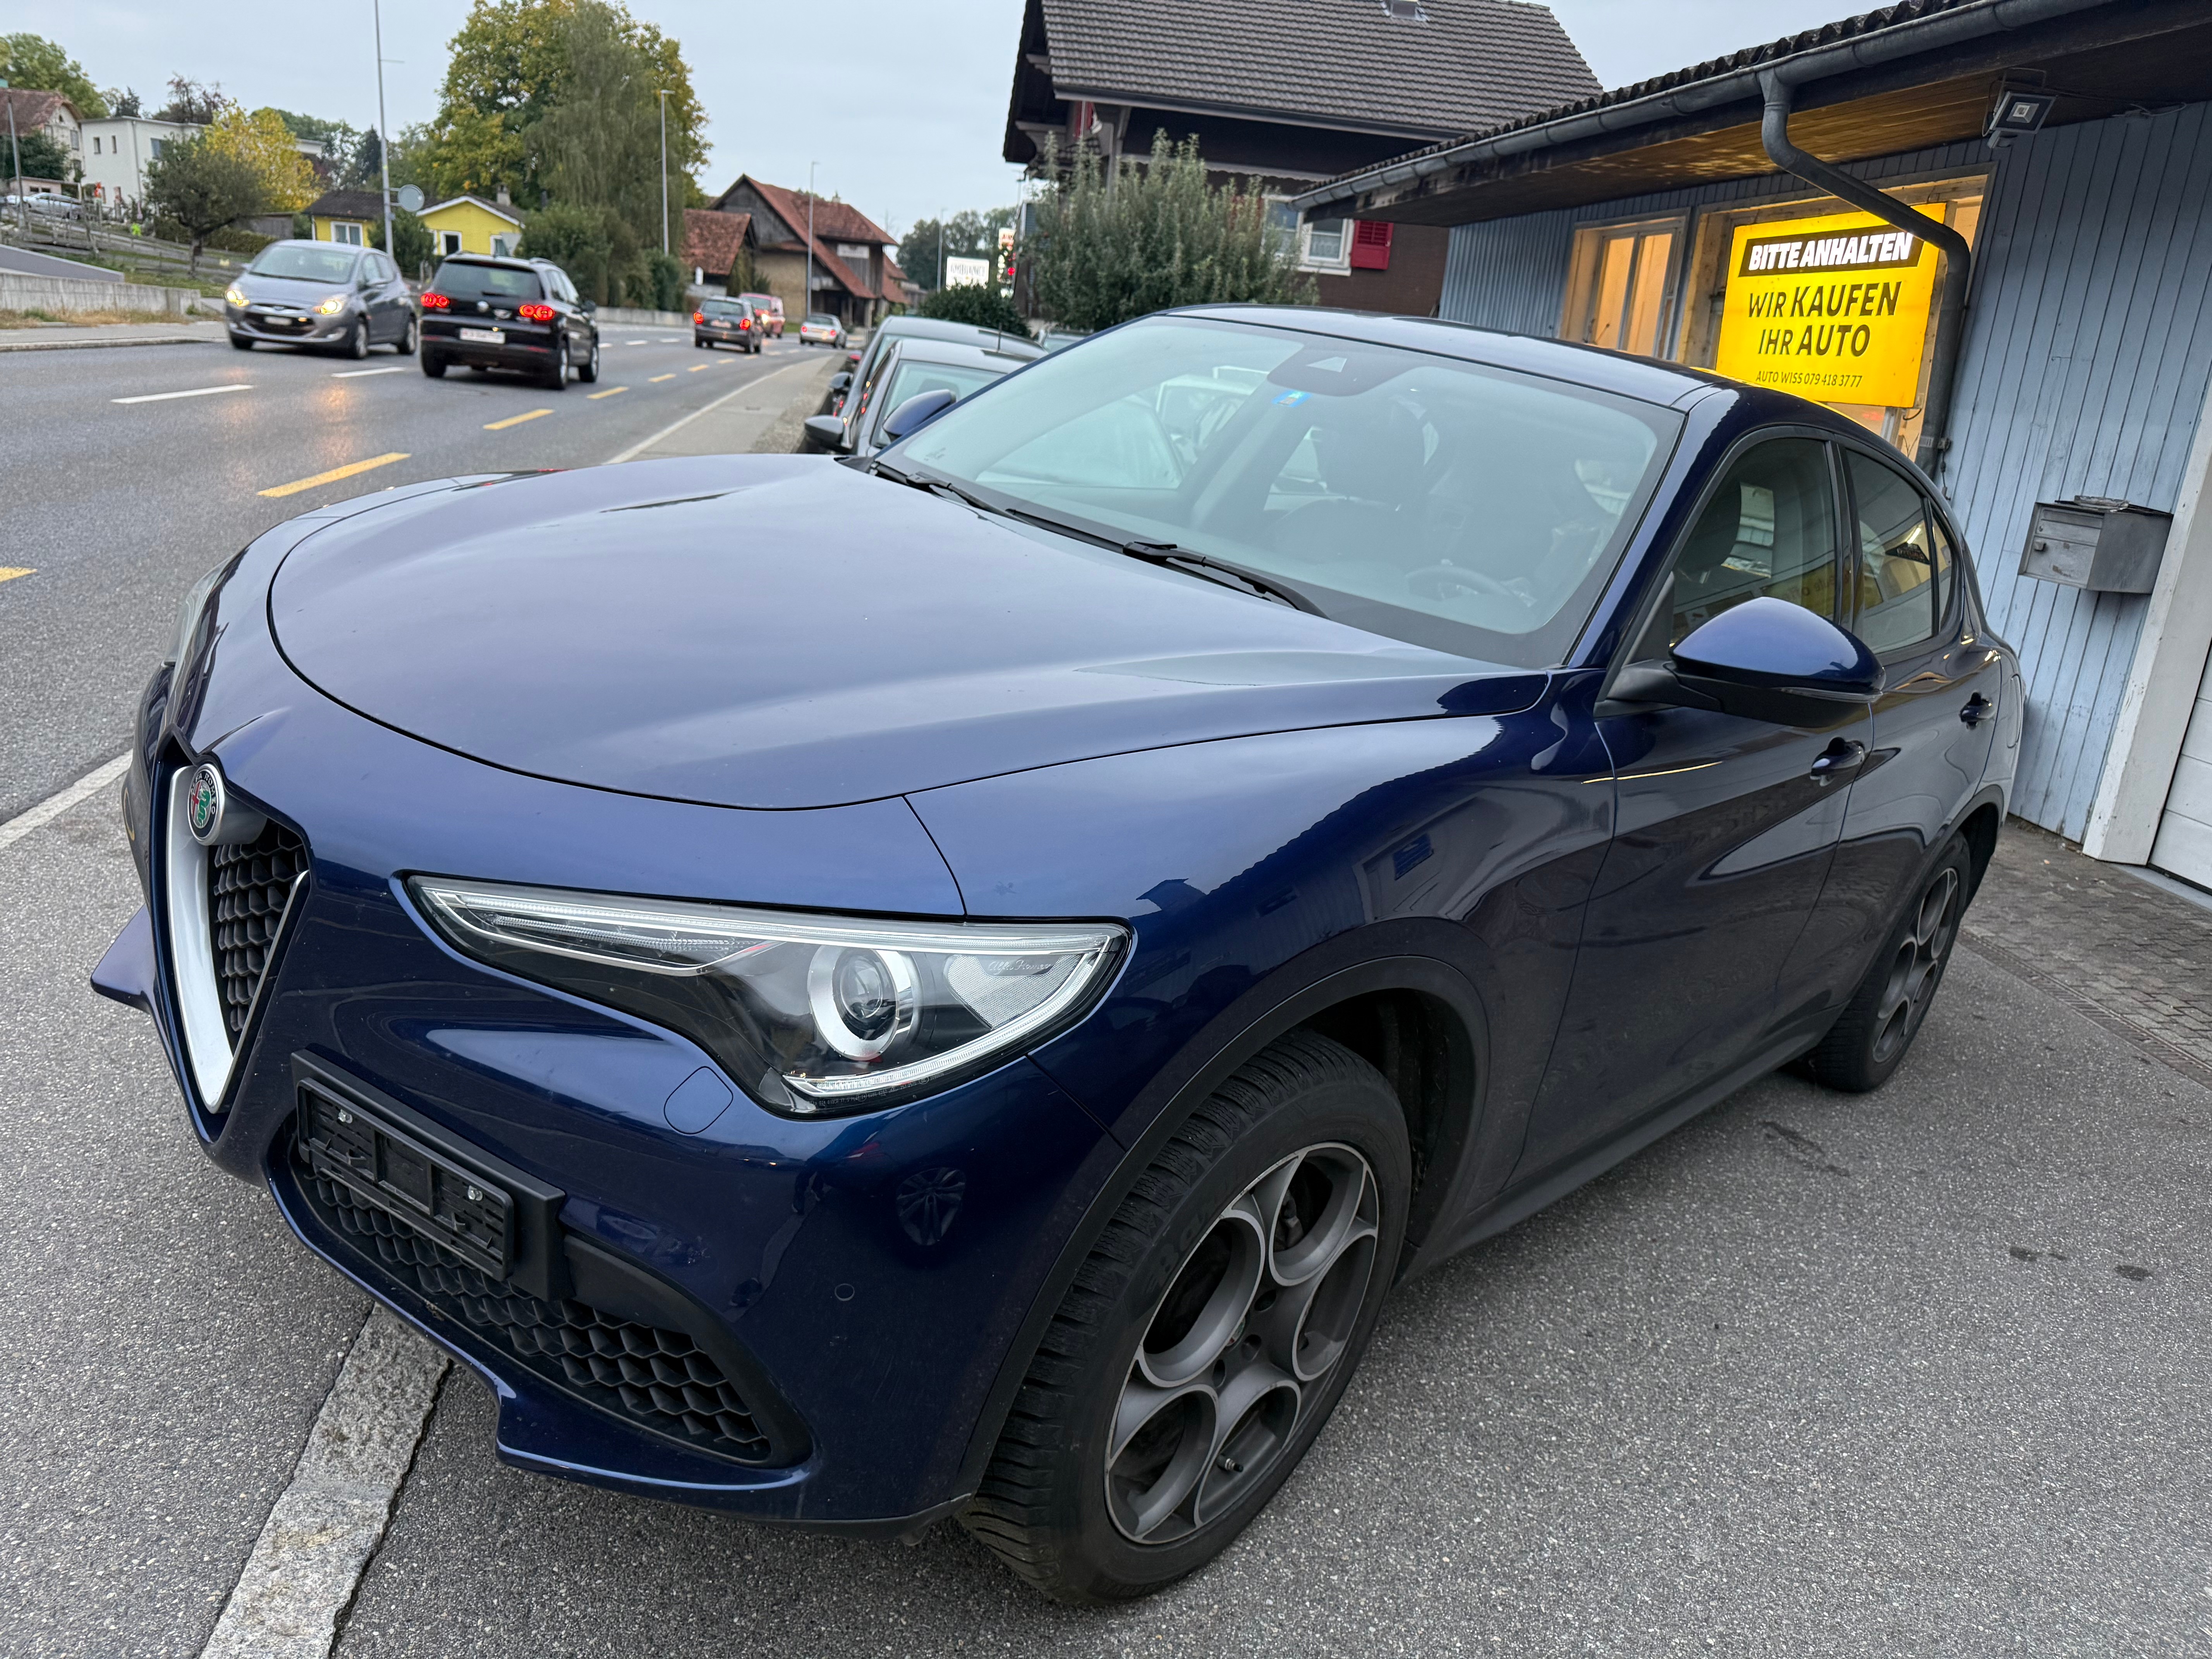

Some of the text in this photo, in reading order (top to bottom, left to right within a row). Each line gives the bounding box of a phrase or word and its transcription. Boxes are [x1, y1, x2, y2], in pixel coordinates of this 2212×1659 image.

[1748, 232, 1914, 271] BITTE ANHALTEN
[1748, 281, 1902, 318] WIR KAUFEN
[1758, 324, 1870, 357] IHR AUTO
[1755, 370, 1779, 383] AUTO
[1781, 371, 1803, 384] WISS
[1804, 373, 1821, 385] 079
[1822, 373, 1838, 386] 418
[204, 773, 216, 815] ROMEO
